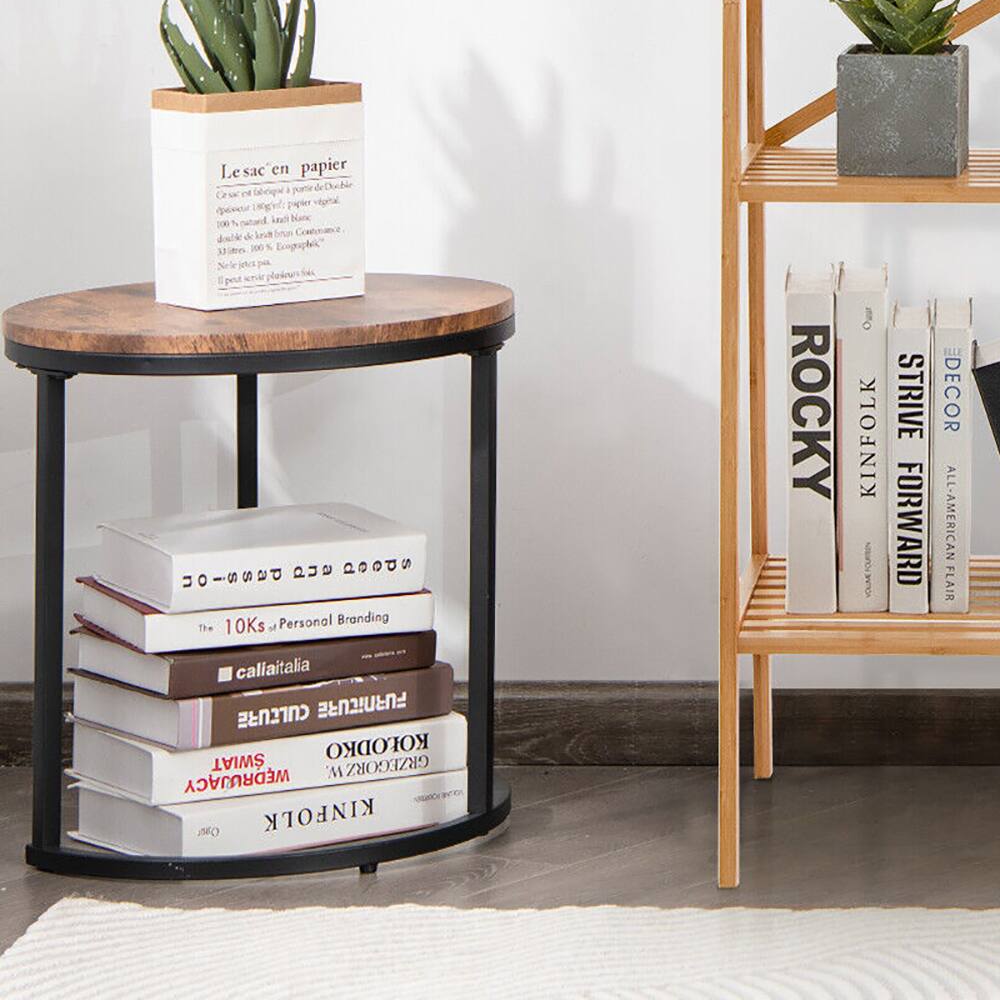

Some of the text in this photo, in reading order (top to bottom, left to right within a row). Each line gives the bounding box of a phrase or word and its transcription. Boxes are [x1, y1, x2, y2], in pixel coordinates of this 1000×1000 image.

[221, 163, 240, 179] Le
[271, 164, 289, 175] en
[301, 157, 347, 177] papier
[944, 357, 961, 432] DECOR
[791, 325, 832, 500] ROCKY
[860, 377, 877, 498] KINFOLK
[897, 354, 924, 586] STRIVE FORWARD
[944, 465, 956, 601] ALL-AMERICAN FLAIR
[182, 558, 412, 588] speed and passion
[199, 624, 214, 632] The
[224, 616, 265, 635] 10Ks
[279, 613, 333, 630] Personal
[337, 611, 390, 626] Branding
[237, 703, 310, 729] CULTURE
[326, 732, 430, 760] KOŁODKO
[211, 753, 265, 772] ŚWIAT
[344, 755, 430, 776] GRZEGORZ
[264, 797, 375, 833] KINFOLK
